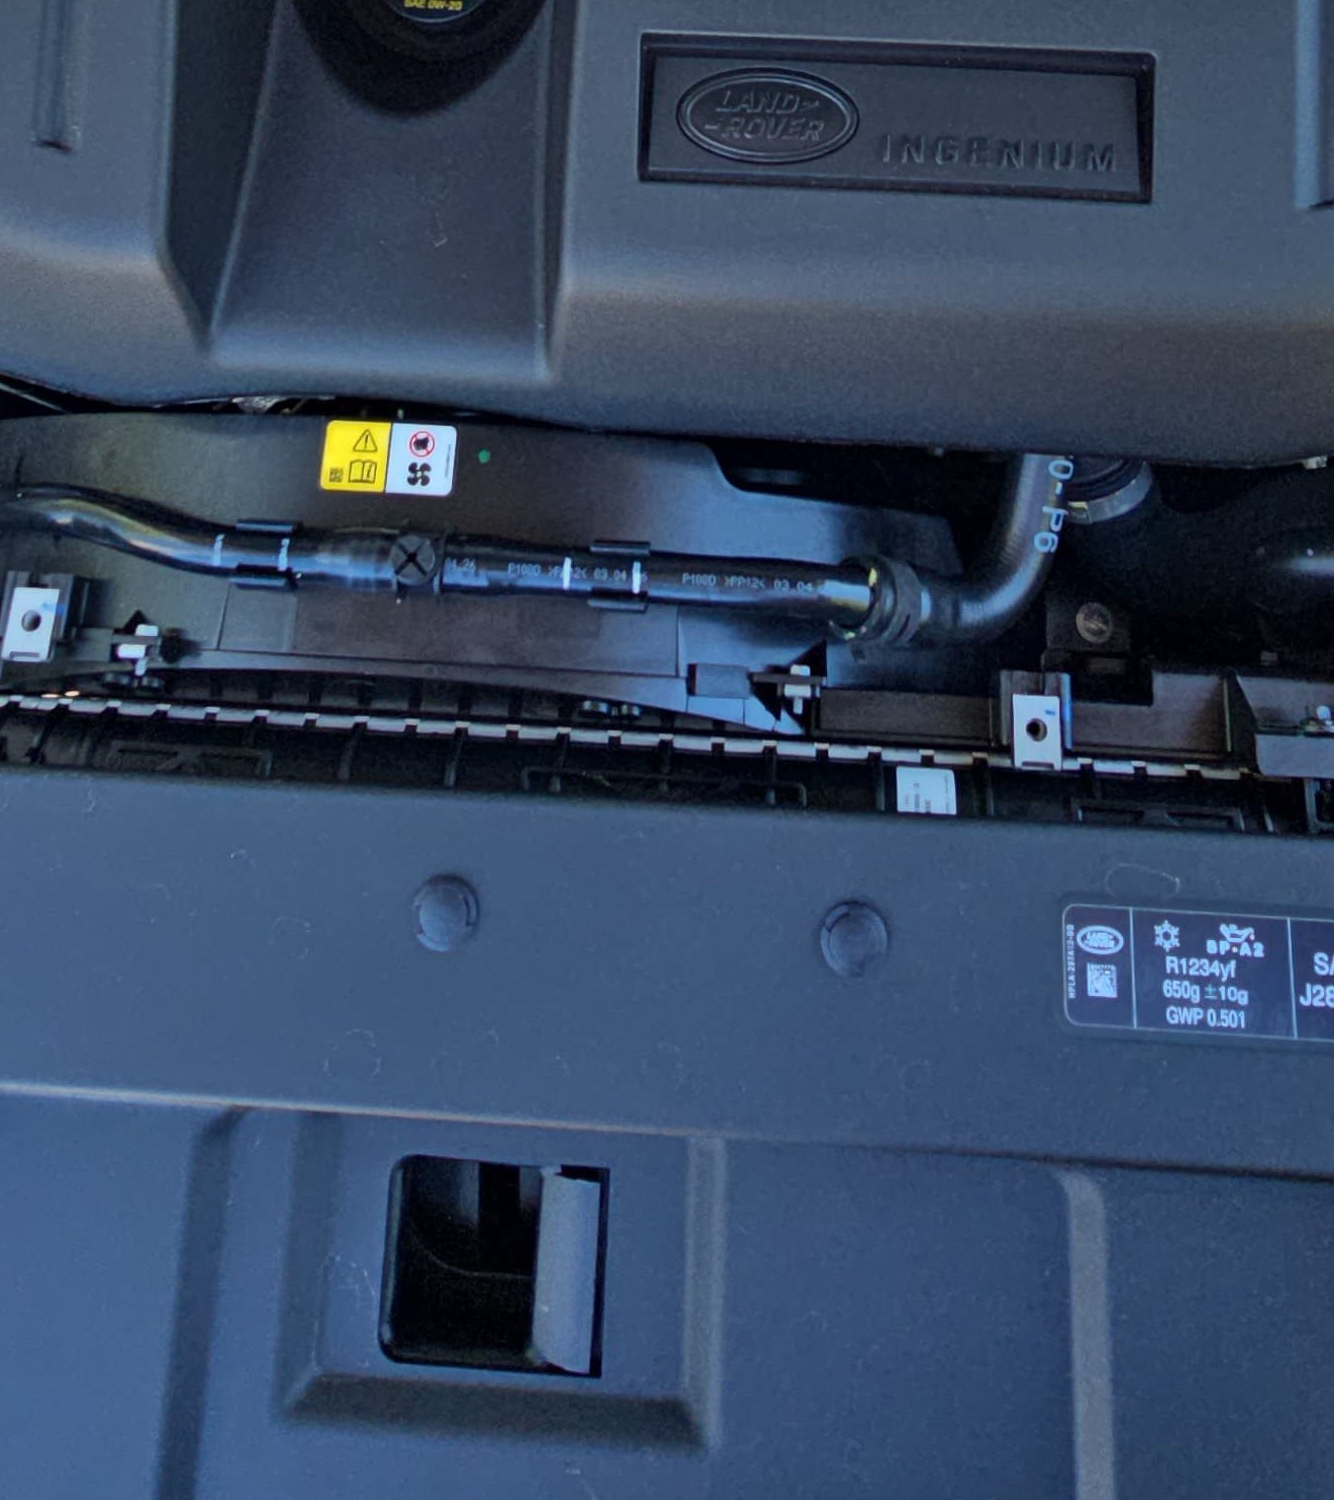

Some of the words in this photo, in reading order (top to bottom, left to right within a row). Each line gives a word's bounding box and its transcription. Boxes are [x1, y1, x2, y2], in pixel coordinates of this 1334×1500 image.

[428, 0, 463, 11] 0W-20
[881, 132, 1120, 175] INGENIUM
[1165, 955, 1237, 983] R1234yf
[1162, 978, 1201, 1005] 650g
[1166, 1004, 1204, 1026] GWP
[1206, 1007, 1246, 1029] 0.501
